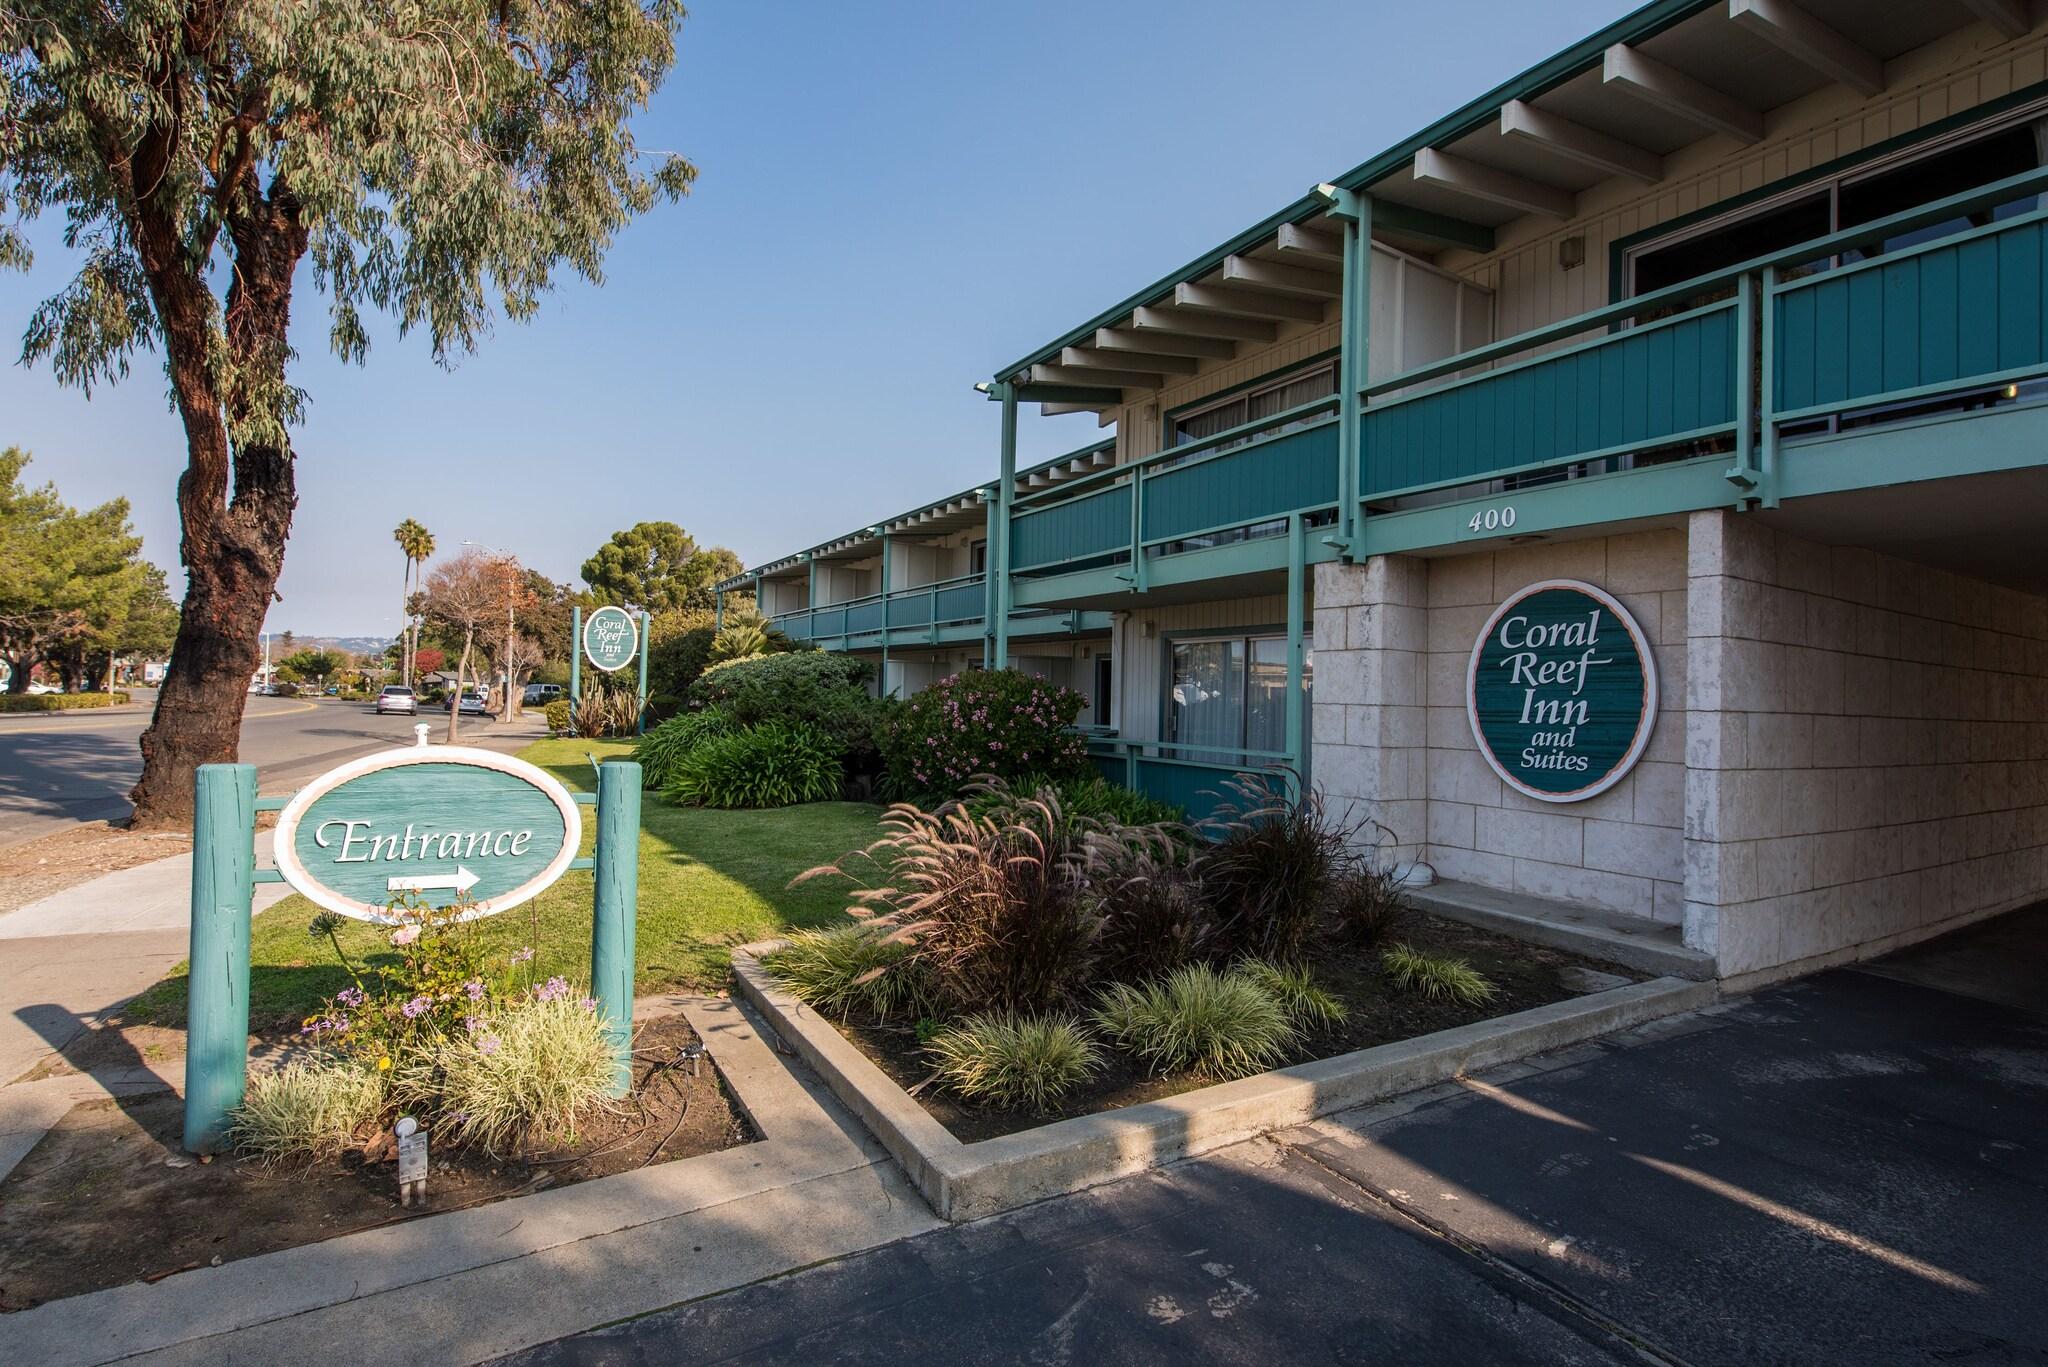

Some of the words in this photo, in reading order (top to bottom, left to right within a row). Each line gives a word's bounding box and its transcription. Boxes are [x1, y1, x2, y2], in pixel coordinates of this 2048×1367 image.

[1468, 506, 1517, 533] 400
[594, 628, 629, 644] Reef
[595, 616, 626, 630] Coral
[1500, 609, 1601, 649] Coral
[600, 641, 621, 653] Inn
[1500, 648, 1613, 696] Reef
[1518, 688, 1590, 726] Inn
[1531, 726, 1576, 748] and
[1520, 747, 1589, 772] Suites
[314, 819, 533, 864] Entrance
